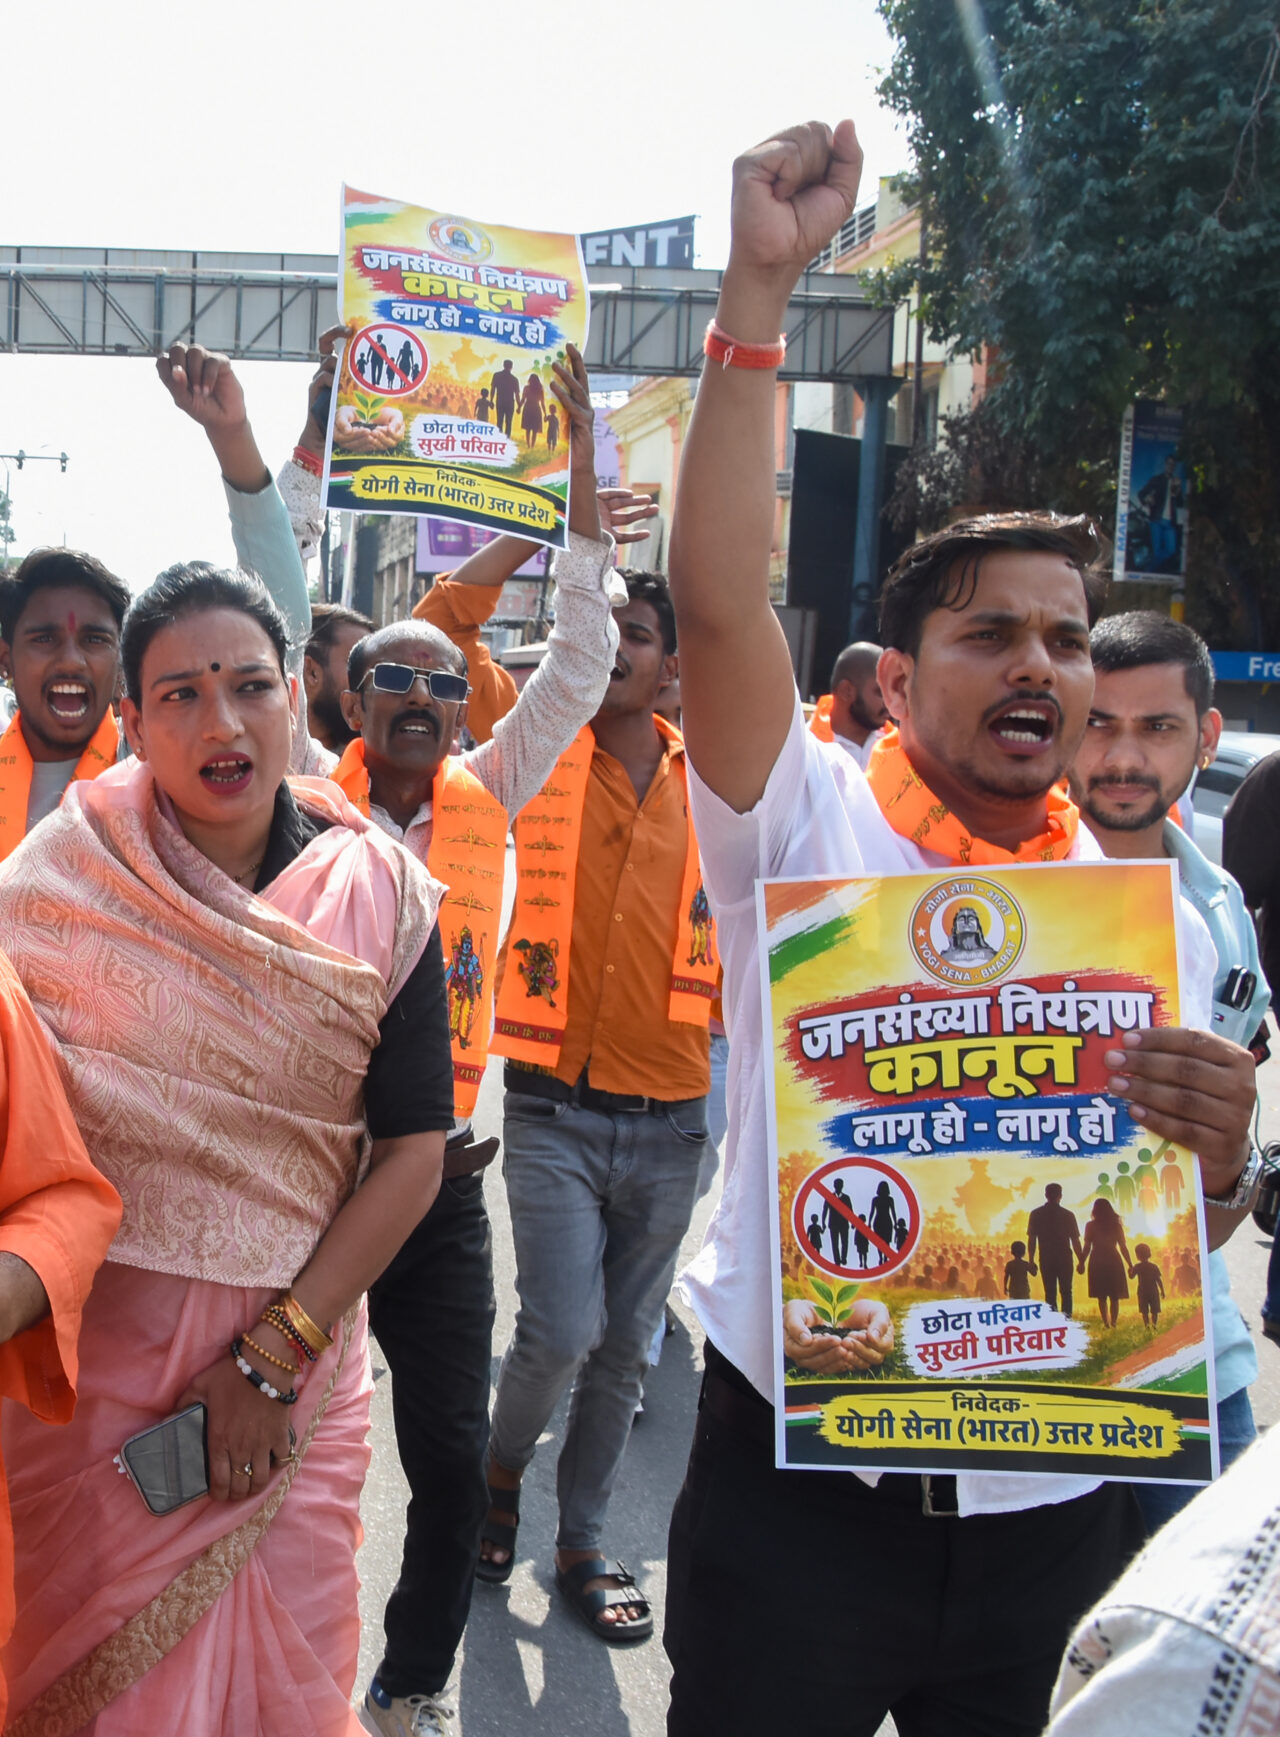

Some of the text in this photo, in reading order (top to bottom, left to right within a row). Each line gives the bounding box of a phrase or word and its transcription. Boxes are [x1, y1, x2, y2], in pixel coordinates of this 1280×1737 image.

[362, 248, 567, 300] जनसंख्या नियंत्रण
[401, 271, 528, 313] कानून
[391, 302, 439, 329] लागू
[440, 304, 461, 327] हो
[479, 313, 524, 344] लागू
[525, 318, 546, 345] हो
[418, 435, 507, 456] सुखी परिवार
[423, 419, 494, 436] छोटा परिवार
[361, 472, 549, 524] योगी सेना (भारत) उत्तर प्रदेश
[919, 941, 941, 969] YOGI
[940, 965, 971, 981] SENA
[980, 940, 1016, 978] BHARAT
[799, 980, 1153, 1060] जनसंख्या नियंत्रण
[865, 1035, 1083, 1098] कानून
[852, 1111, 934, 1152] लागू
[931, 1102, 967, 1142] हो
[996, 1108, 1080, 1152] लागू
[1077, 1097, 1116, 1143] हो
[921, 1302, 1043, 1335] छोटा परिवार
[915, 1326, 1068, 1372] सुखी परिवार
[836, 1408, 1164, 1448] योगी सेना (भारत) उत्तर प्रदेश
